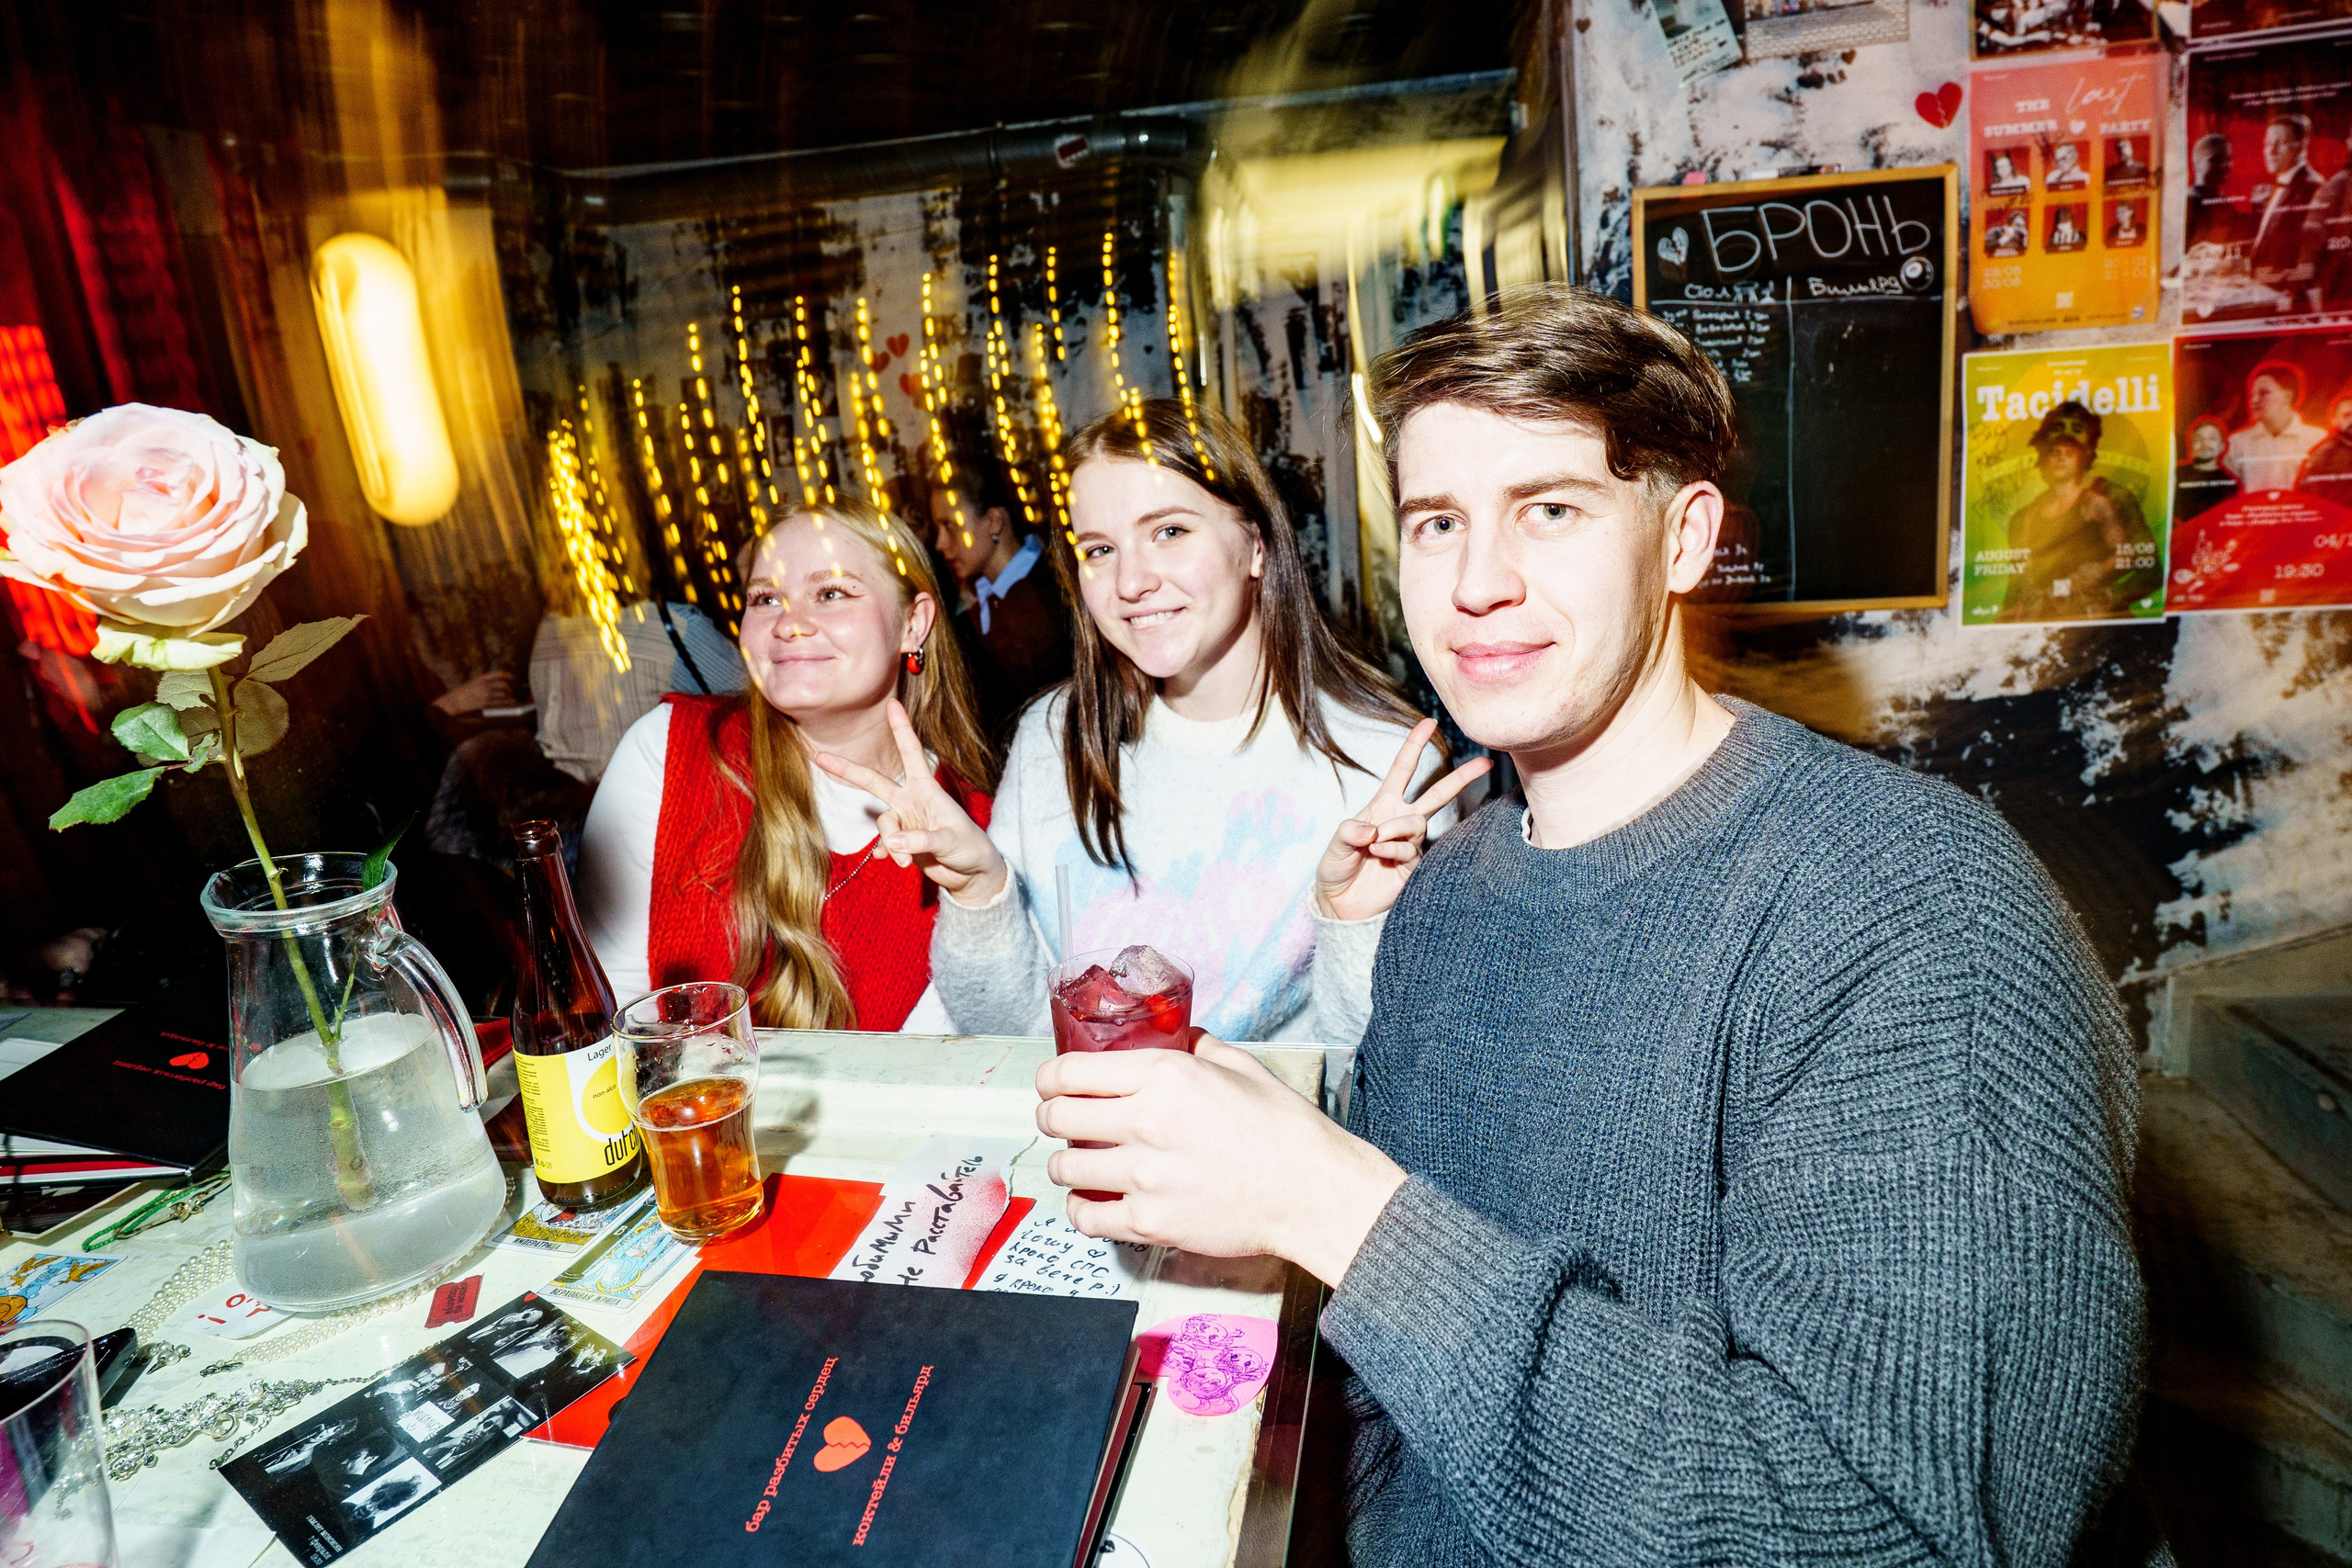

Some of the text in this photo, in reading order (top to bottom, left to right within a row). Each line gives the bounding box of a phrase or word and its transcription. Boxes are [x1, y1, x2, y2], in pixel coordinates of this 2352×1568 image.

[2015, 98, 2051, 113] THE
[1984, 118, 2152, 138] SUMMER PARTY
[1701, 195, 1930, 272] БРОНЬ
[1976, 374, 2161, 422] Tacidelli
[1975, 548, 2031, 562] AUGUST
[1974, 562, 2027, 576] FRIDAY
[587, 1043, 612, 1062] Lager
[514, 1237, 560, 1250] ИМПЕРАТРИЦА
[551, 1287, 621, 1305] ВЕРХОВНАЯ ЖРИЦА
[745, 1357, 840, 1533] бар разбитых сердец
[852, 1365, 935, 1547] коктейли & бильярд
